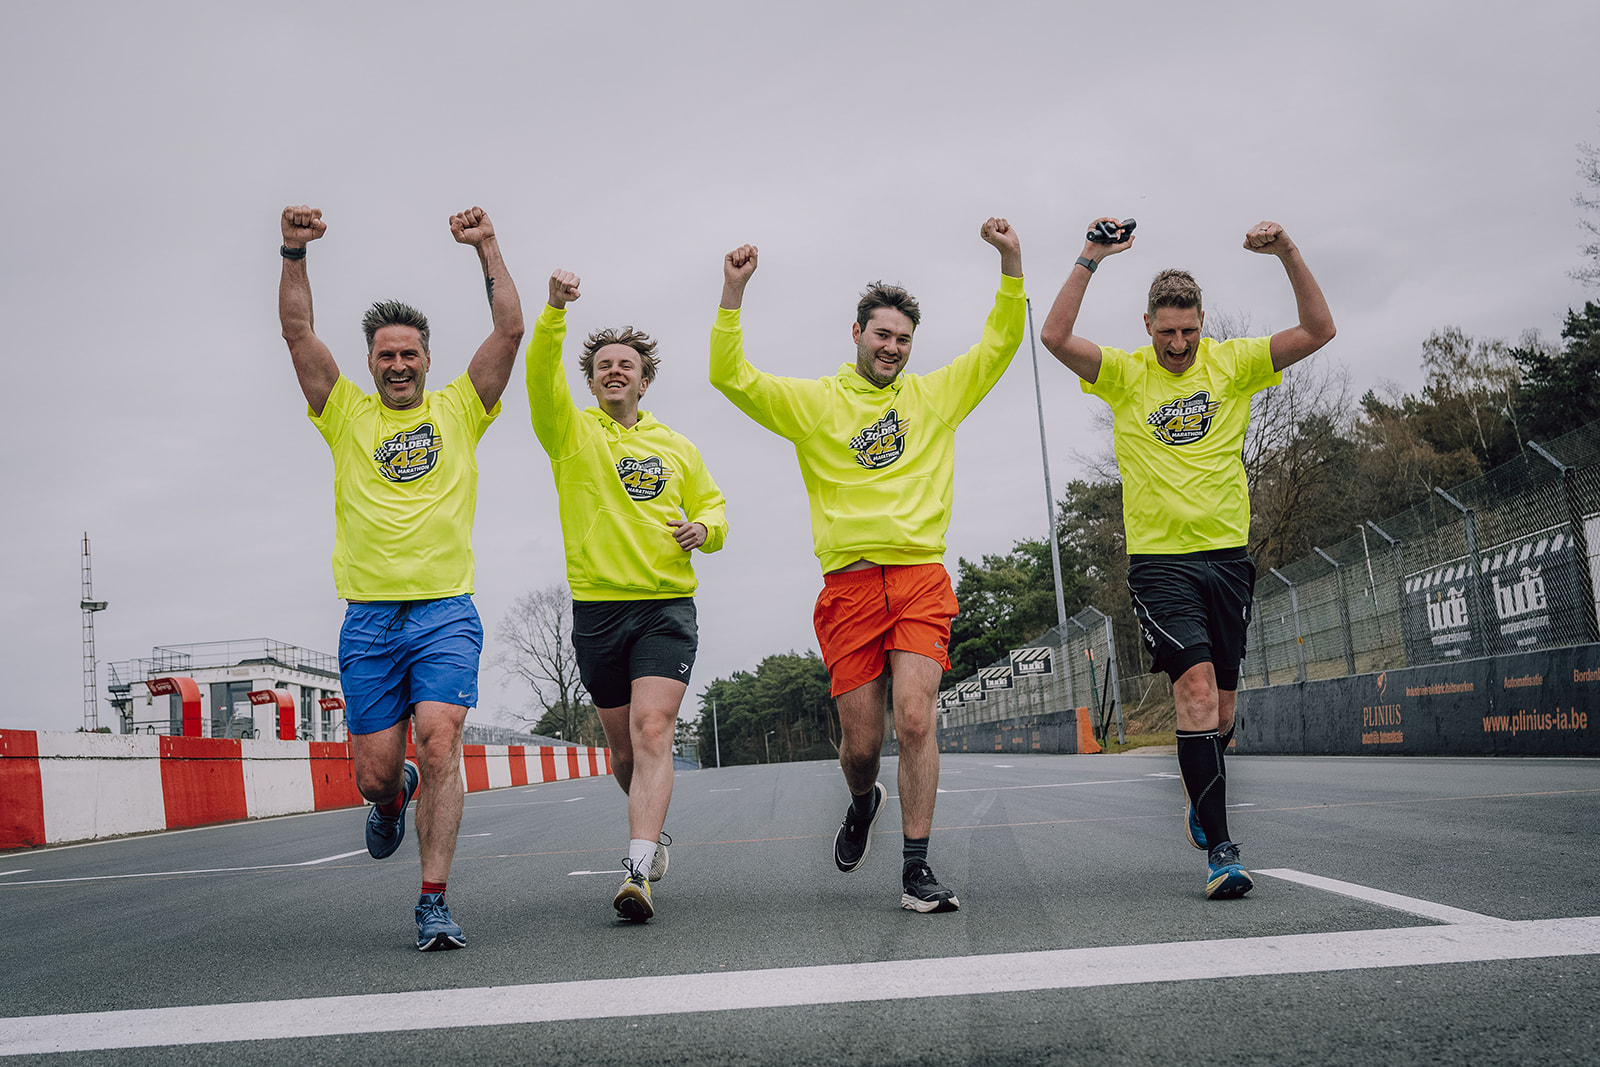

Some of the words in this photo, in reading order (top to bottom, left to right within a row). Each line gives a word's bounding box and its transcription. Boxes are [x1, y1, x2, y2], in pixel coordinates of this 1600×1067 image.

[1164, 404, 1207, 416] ZOLDER
[1165, 413, 1203, 432] 42
[1171, 430, 1203, 438] MARATHON
[388, 438, 431, 452] ZOLDER
[866, 433, 897, 456] 42
[390, 447, 428, 469] 42
[397, 464, 430, 474] MARATHON
[622, 471, 659, 490] 42
[1363, 704, 1402, 727] PLINIUS
[1483, 707, 1588, 736] www.plinius-ia.be
